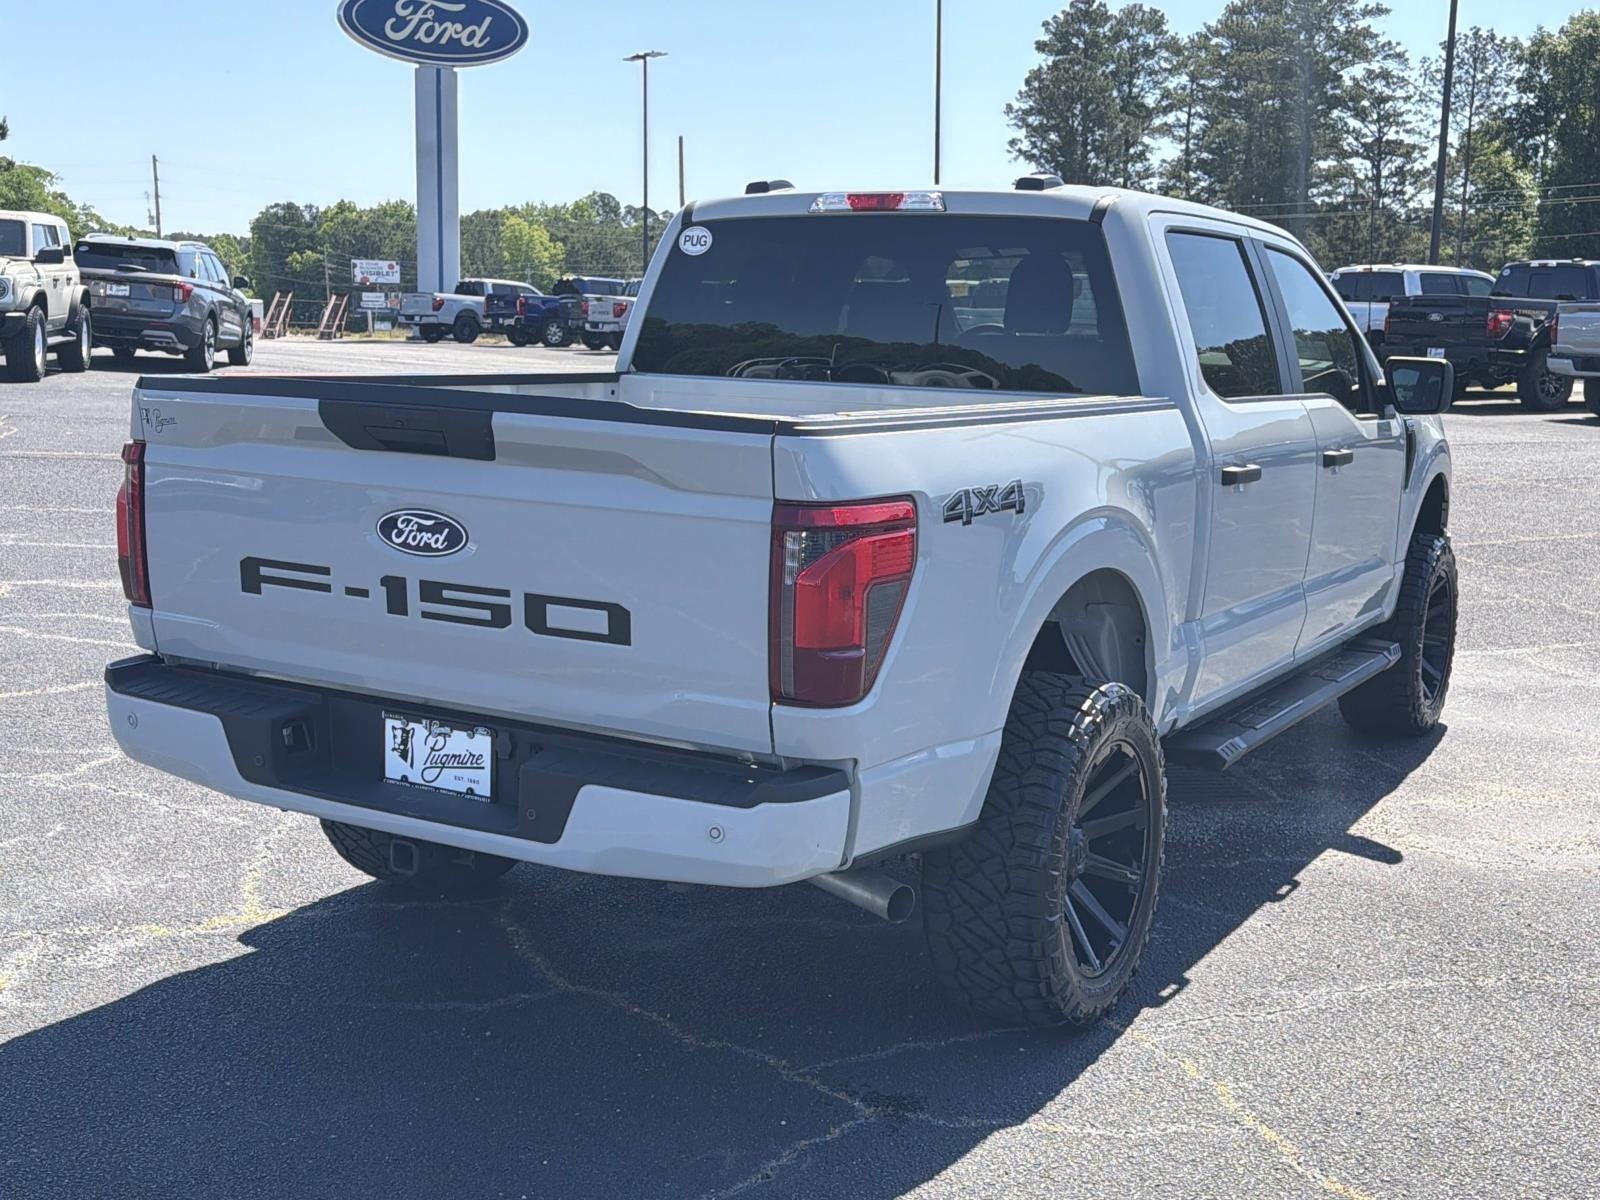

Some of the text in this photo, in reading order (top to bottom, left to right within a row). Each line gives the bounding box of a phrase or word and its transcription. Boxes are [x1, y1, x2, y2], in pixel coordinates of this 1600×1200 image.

[384, 0, 493, 48] Ford
[683, 234, 708, 247] PUG
[392, 515, 449, 549] Ford
[239, 556, 632, 646] F-150
[421, 730, 485, 783] Pugmire
